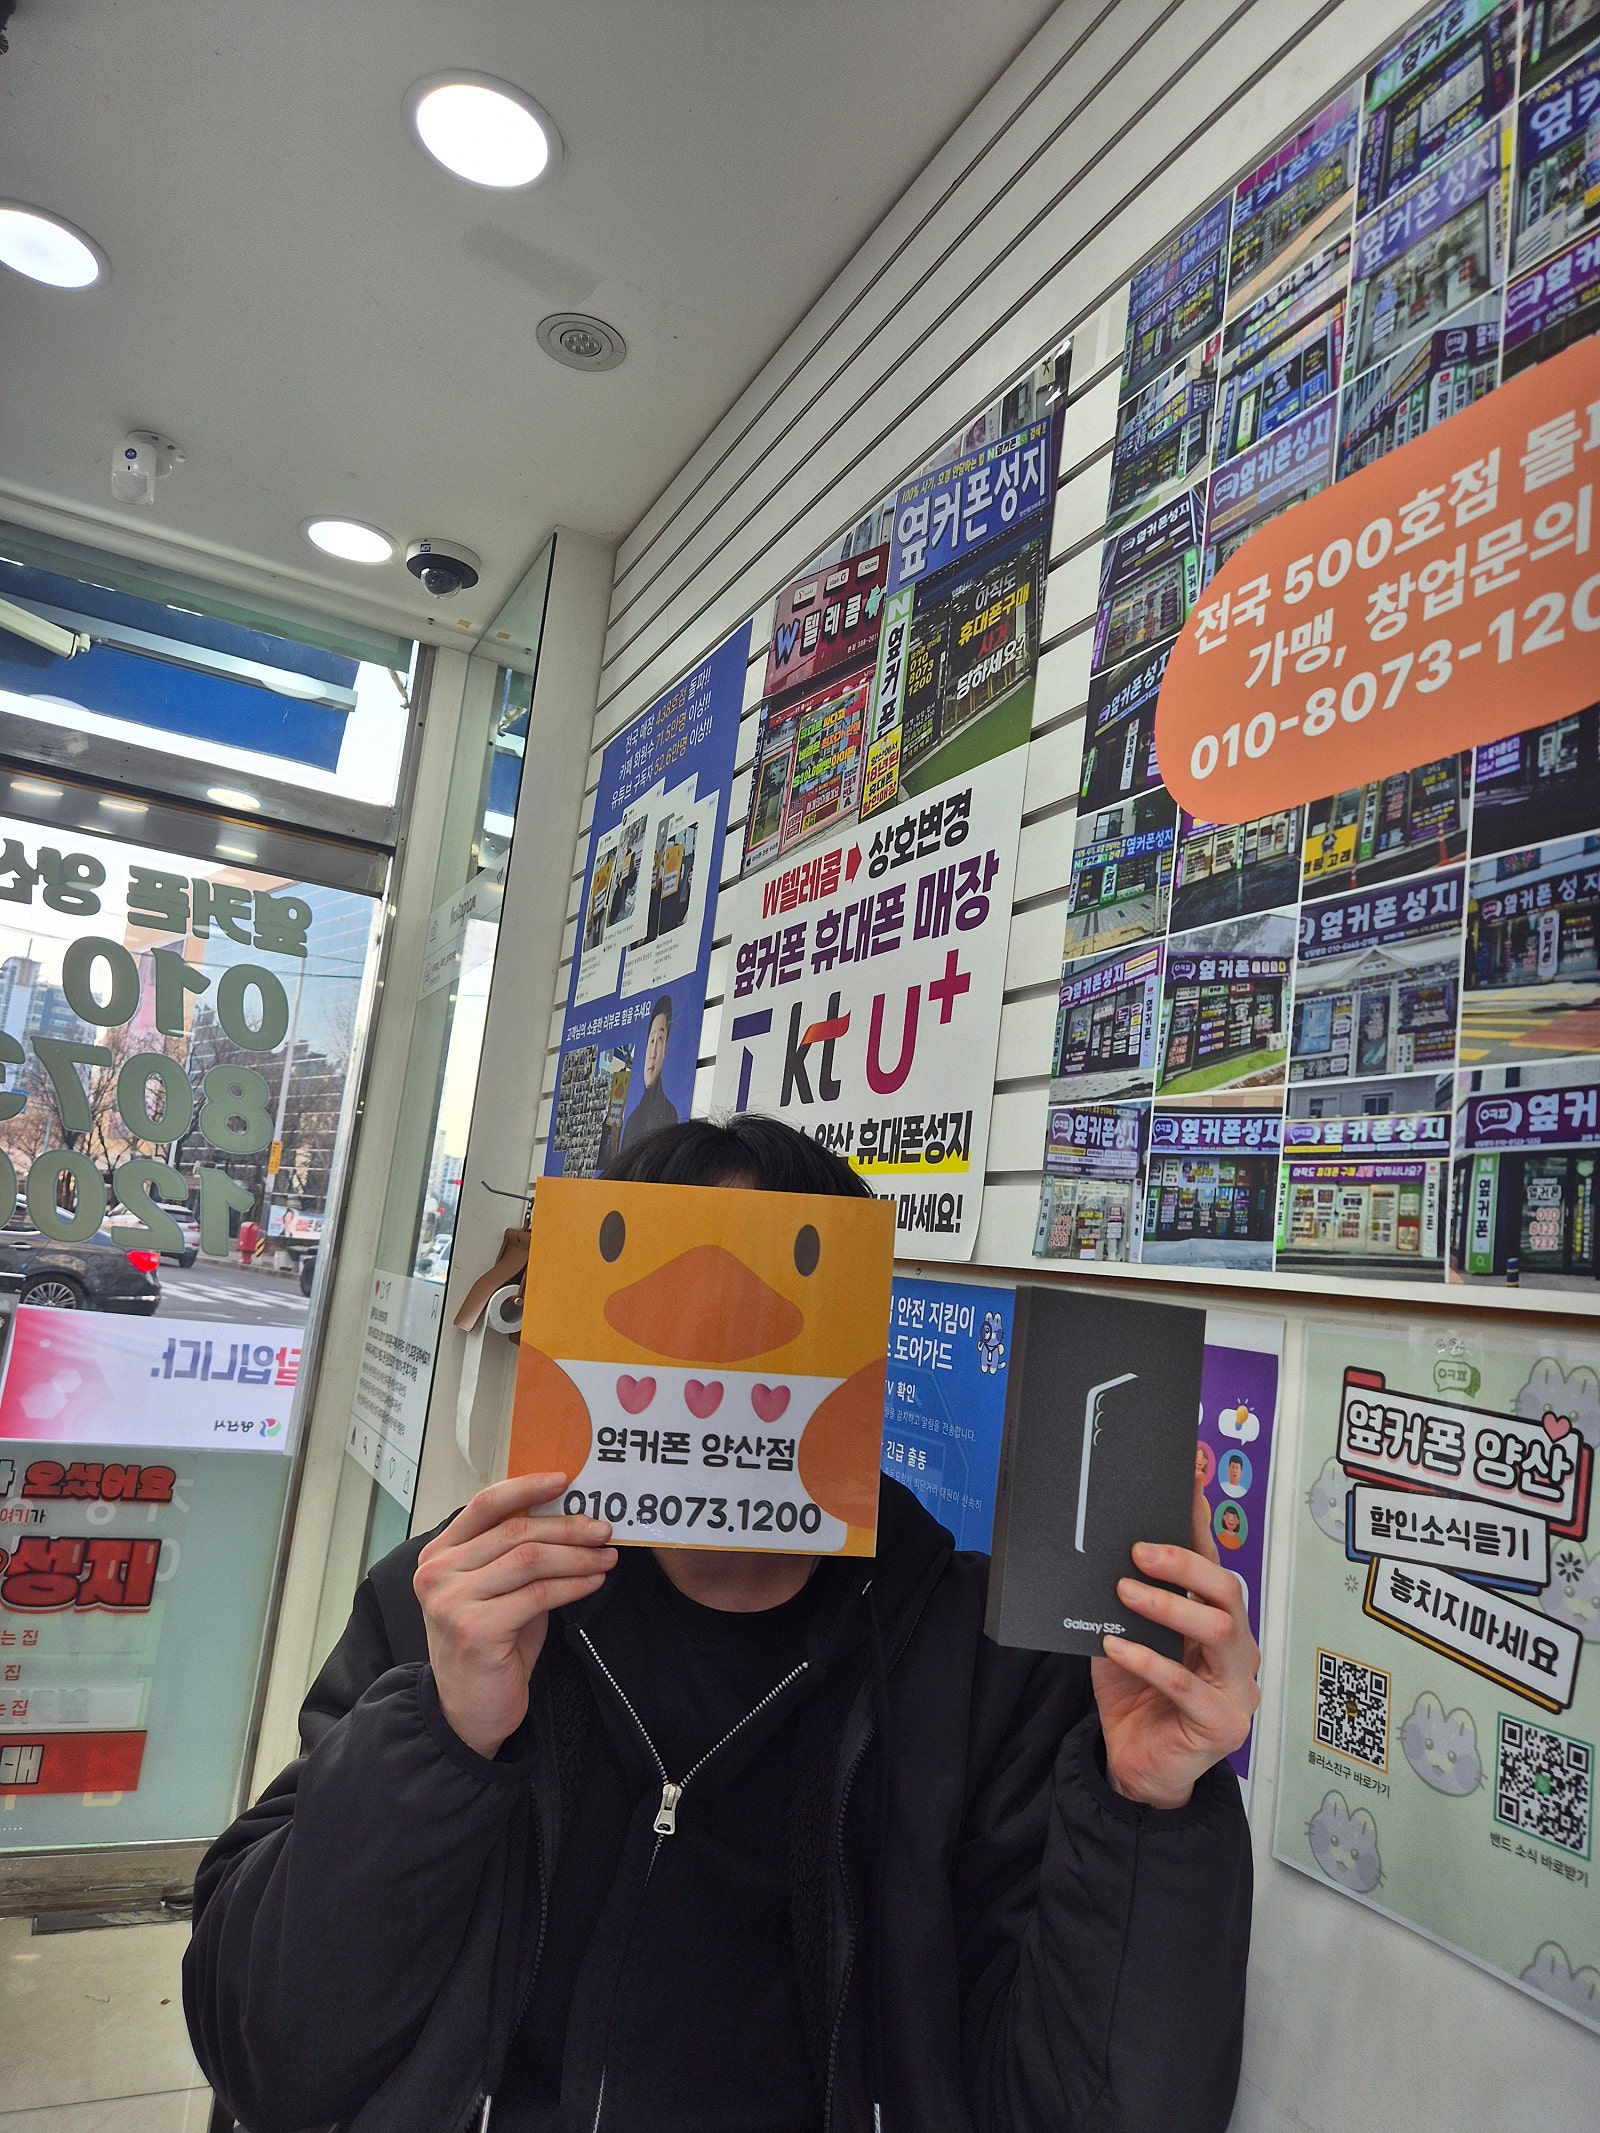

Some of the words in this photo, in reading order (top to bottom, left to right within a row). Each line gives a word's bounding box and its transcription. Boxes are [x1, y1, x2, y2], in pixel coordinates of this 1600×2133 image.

[1362, 138, 1498, 271] 옆커폰성지
[1240, 408, 1332, 497] 옆커폰성지
[898, 439, 1046, 583] 옆커폰성지
[1136, 501, 1190, 546] 옆커폰성지
[1193, 572, 1272, 655] 전국
[1283, 446, 1501, 606] 500호점
[975, 573, 1016, 611] 아직도
[1244, 607, 1348, 690] 가맹,
[1364, 484, 1593, 642] 창업문의
[776, 593, 862, 662] W텔레콤
[888, 595, 911, 624] N
[957, 581, 1030, 647] 휴대폰구매
[909, 659, 934, 685] 8073
[910, 652, 928, 672] 010
[908, 672, 932, 697] 1200
[625, 730, 639, 754] 전국
[639, 714, 654, 740] 매장
[655, 685, 687, 727] 438호점
[688, 665, 712, 701] 돌파!!
[619, 760, 633, 780] 카페
[633, 742, 654, 767] 회원수
[655, 710, 687, 751] 71.5만명
[688, 691, 712, 721] 이상!!
[611, 783, 632, 810] 유튜브
[633, 764, 654, 793] 구독자
[653, 734, 688, 776] 52.6만명
[689, 716, 712, 746] 이상!!
[866, 750, 899, 784] 18년된
[869, 771, 893, 796] 휴대폰
[862, 782, 896, 815] 할인매장
[762, 848, 843, 919] W텔레콤
[868, 788, 972, 879] 상호변경
[1127, 828, 1173, 855] 옆커폰성지
[733, 922, 807, 998] 옆커폰
[810, 883, 906, 975] 휴대폰
[913, 849, 1000, 941] 매장
[1321, 880, 1458, 942] 옆커폰성지
[1073, 963, 1124, 999] 옆커폰성지
[1199, 959, 1250, 980] 옆커폰
[566, 1022, 586, 1041] 고객님의
[586, 1016, 603, 1035] 소중한
[603, 1012, 620, 1031] 리뷰로
[621, 1007, 633, 1026] 힘을
[634, 1000, 652, 1021] 주세요
[780, 991, 851, 1107] kt
[865, 949, 971, 1095] U+
[1181, 1118, 1282, 1145] 옆커폰성지
[1324, 1117, 1445, 1144] 옆커폰성지
[1480, 1107, 1509, 1121] ㅇㅋㅍ
[1528, 1090, 1597, 1132] 옆커
[857, 1110, 973, 1165] 휴대폰성지
[1074, 1115, 1139, 1149] 옆커폰성지
[1481, 1158, 1492, 1171] N
[897, 1192, 964, 1234] 마세요!
[1476, 1179, 1491, 1238] 옆커폰
[1529, 1222, 1559, 1235] 8123
[1536, 1208, 1560, 1220] 010
[1530, 1237, 1558, 1249] 1232
[898, 1297, 926, 1328] 안전
[928, 1302, 975, 1338] 지킴이
[894, 1335, 952, 1370] 도어가드
[886, 1380, 894, 1397] V
[897, 1381, 916, 1403] 확인
[1438, 1368, 1467, 1384] ㅇㅋㅍ
[896, 1409, 920, 1428] 감지하고
[922, 1415, 940, 1433] 알림을
[942, 1422, 976, 1442] 전송합니다.
[597, 1427, 691, 1466] 옆커폰
[701, 1433, 796, 1472] 양산점
[887, 1440, 905, 1462] 긴급
[908, 1447, 927, 1471] 출동
[1346, 1399, 1466, 1477] 옆커폰
[1475, 1428, 1574, 1504] 양산
[21, 1461, 176, 1503] 오셨어요
[913, 1475, 938, 1497] 최단거리
[940, 1484, 960, 1505] 대원이
[564, 1490, 822, 1534] 010.8073.1200
[1370, 1505, 1529, 1561] 할인소식듣기
[0, 1536, 162, 1611] 성지
[22, 1630, 38, 1646] 집
[1064, 1618, 1102, 1635] Galaxy
[1103, 1621, 1127, 1635] S25+
[1390, 1567, 1560, 1678] 놓치지마세요
[5, 1665, 21, 1681] 집
[12, 1700, 28, 1716] 집
[1307, 1750, 1351, 1780] 플러스친구
[1353, 1767, 1391, 1799] 바로가기
[1490, 1831, 1512, 1850] 밴드
[1515, 1841, 1538, 1866] 소식
[1541, 1850, 1589, 1889] 바로받기
